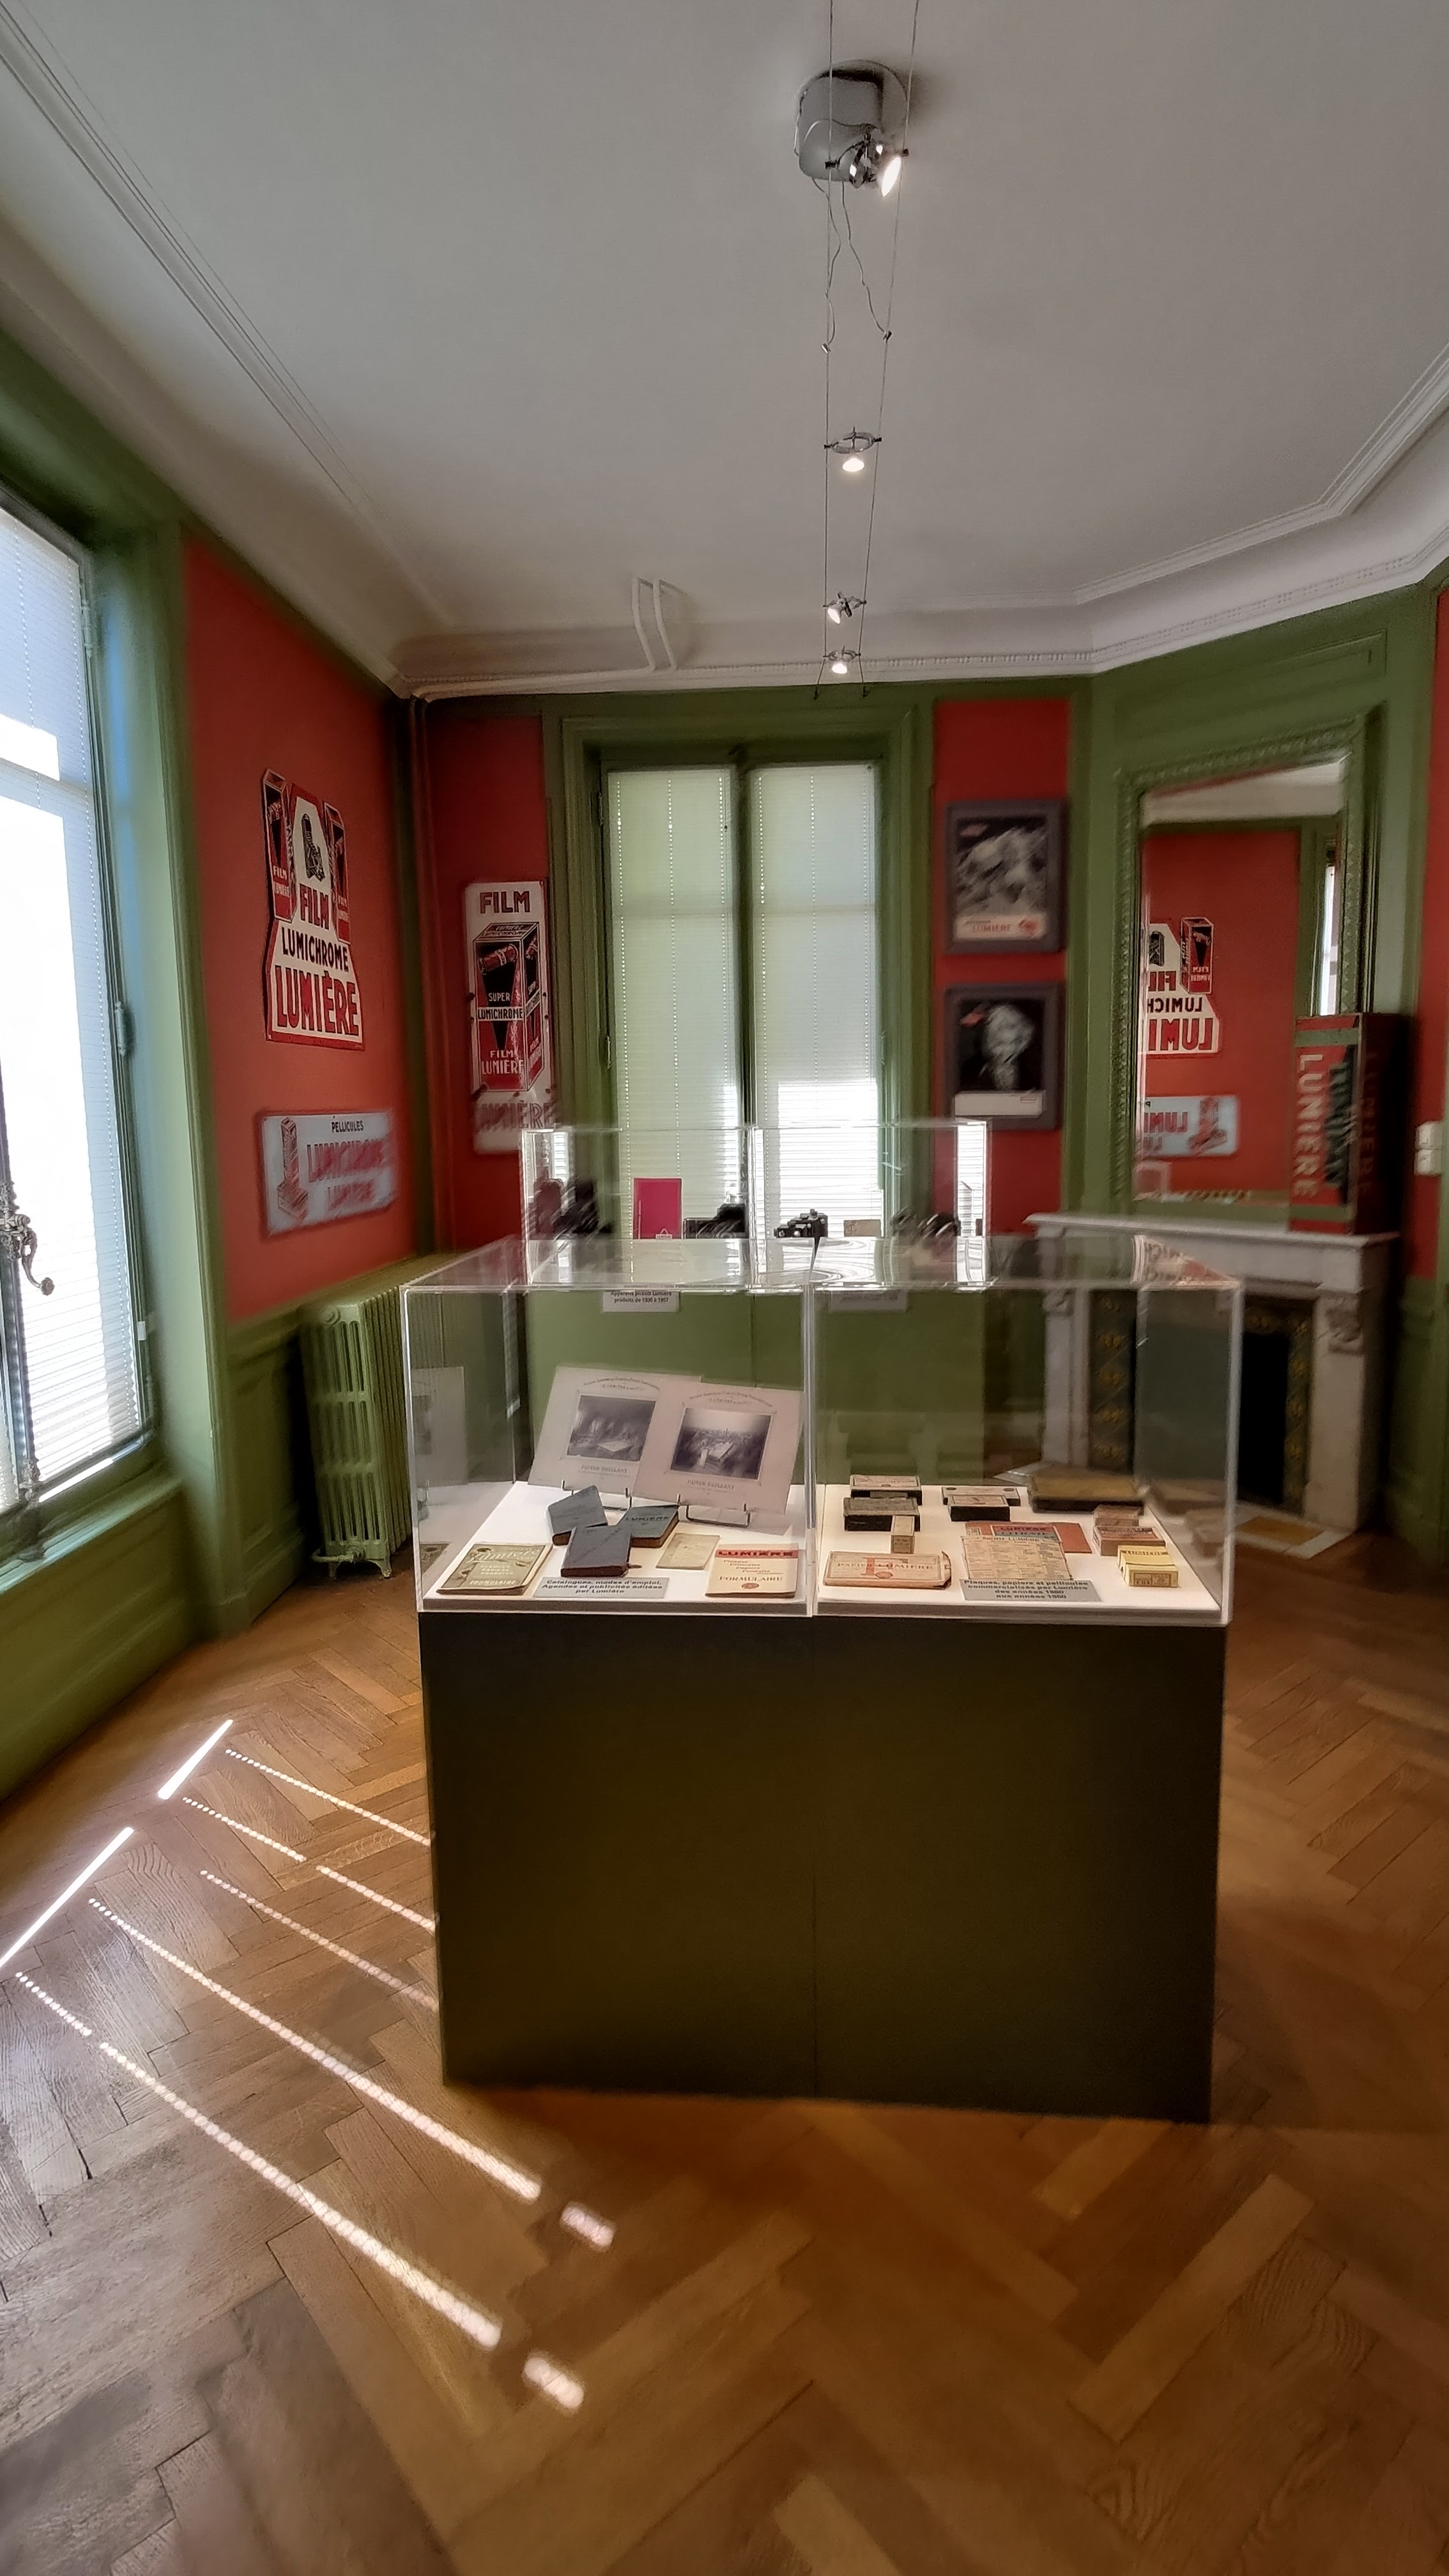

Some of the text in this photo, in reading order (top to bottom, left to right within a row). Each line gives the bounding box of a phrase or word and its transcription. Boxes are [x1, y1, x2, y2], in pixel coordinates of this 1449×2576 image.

[273, 866, 288, 880] FILM
[300, 883, 330, 930] FILM
[480, 891, 530, 914] FILM
[282, 926, 349, 972] LUMICHROME
[488, 992, 510, 1002] SUPER
[478, 1008, 523, 1020] LUMICHROME
[490, 1050, 514, 1059] FILM
[332, 1120, 364, 1133] PELLICULES
